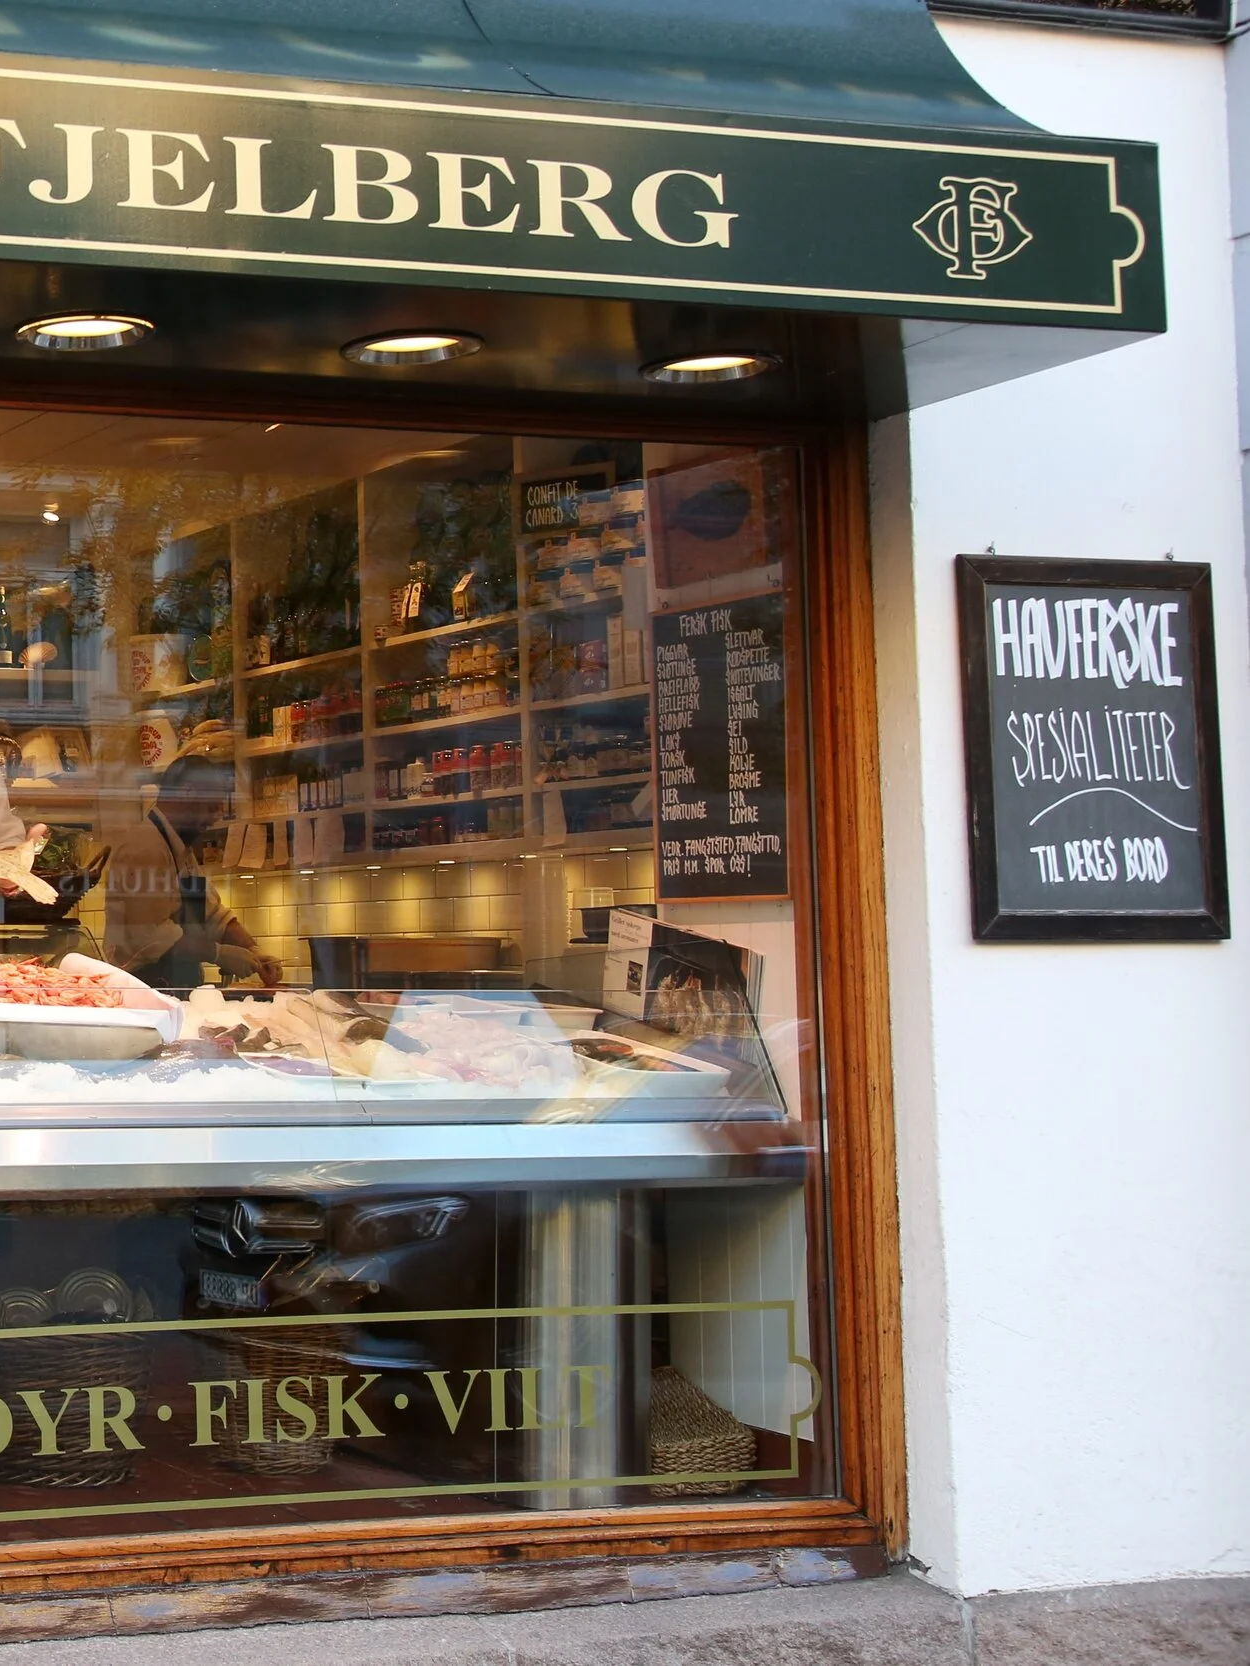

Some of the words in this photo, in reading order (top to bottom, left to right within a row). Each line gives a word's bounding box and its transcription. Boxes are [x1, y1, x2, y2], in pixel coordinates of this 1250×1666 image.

[566, 481, 579, 499] DE
[526, 505, 564, 527] CANARD
[679, 611, 708, 637] FERSK
[710, 609, 733, 632] FISK
[725, 628, 765, 649] SLETTVAR
[992, 597, 1182, 688] HAVFERSKE
[658, 693, 700, 714] HELLEFISK
[727, 720, 742, 737] SEI
[659, 732, 681, 751] LAKS
[728, 736, 748, 755] SILD
[660, 749, 686, 769] TORSK
[660, 766, 696, 787] TUNFISK
[728, 771, 762, 791] BROSME
[729, 791, 746, 809] LYR
[729, 806, 759, 825] LOMRE
[663, 857, 681, 876] PRIS
[1030, 844, 1064, 883] TIL
[1065, 836, 1118, 883] DERES
[1123, 836, 1169, 884] BORD
[188, 1372, 386, 1447] FISK
[424, 1365, 611, 1435] VILT
